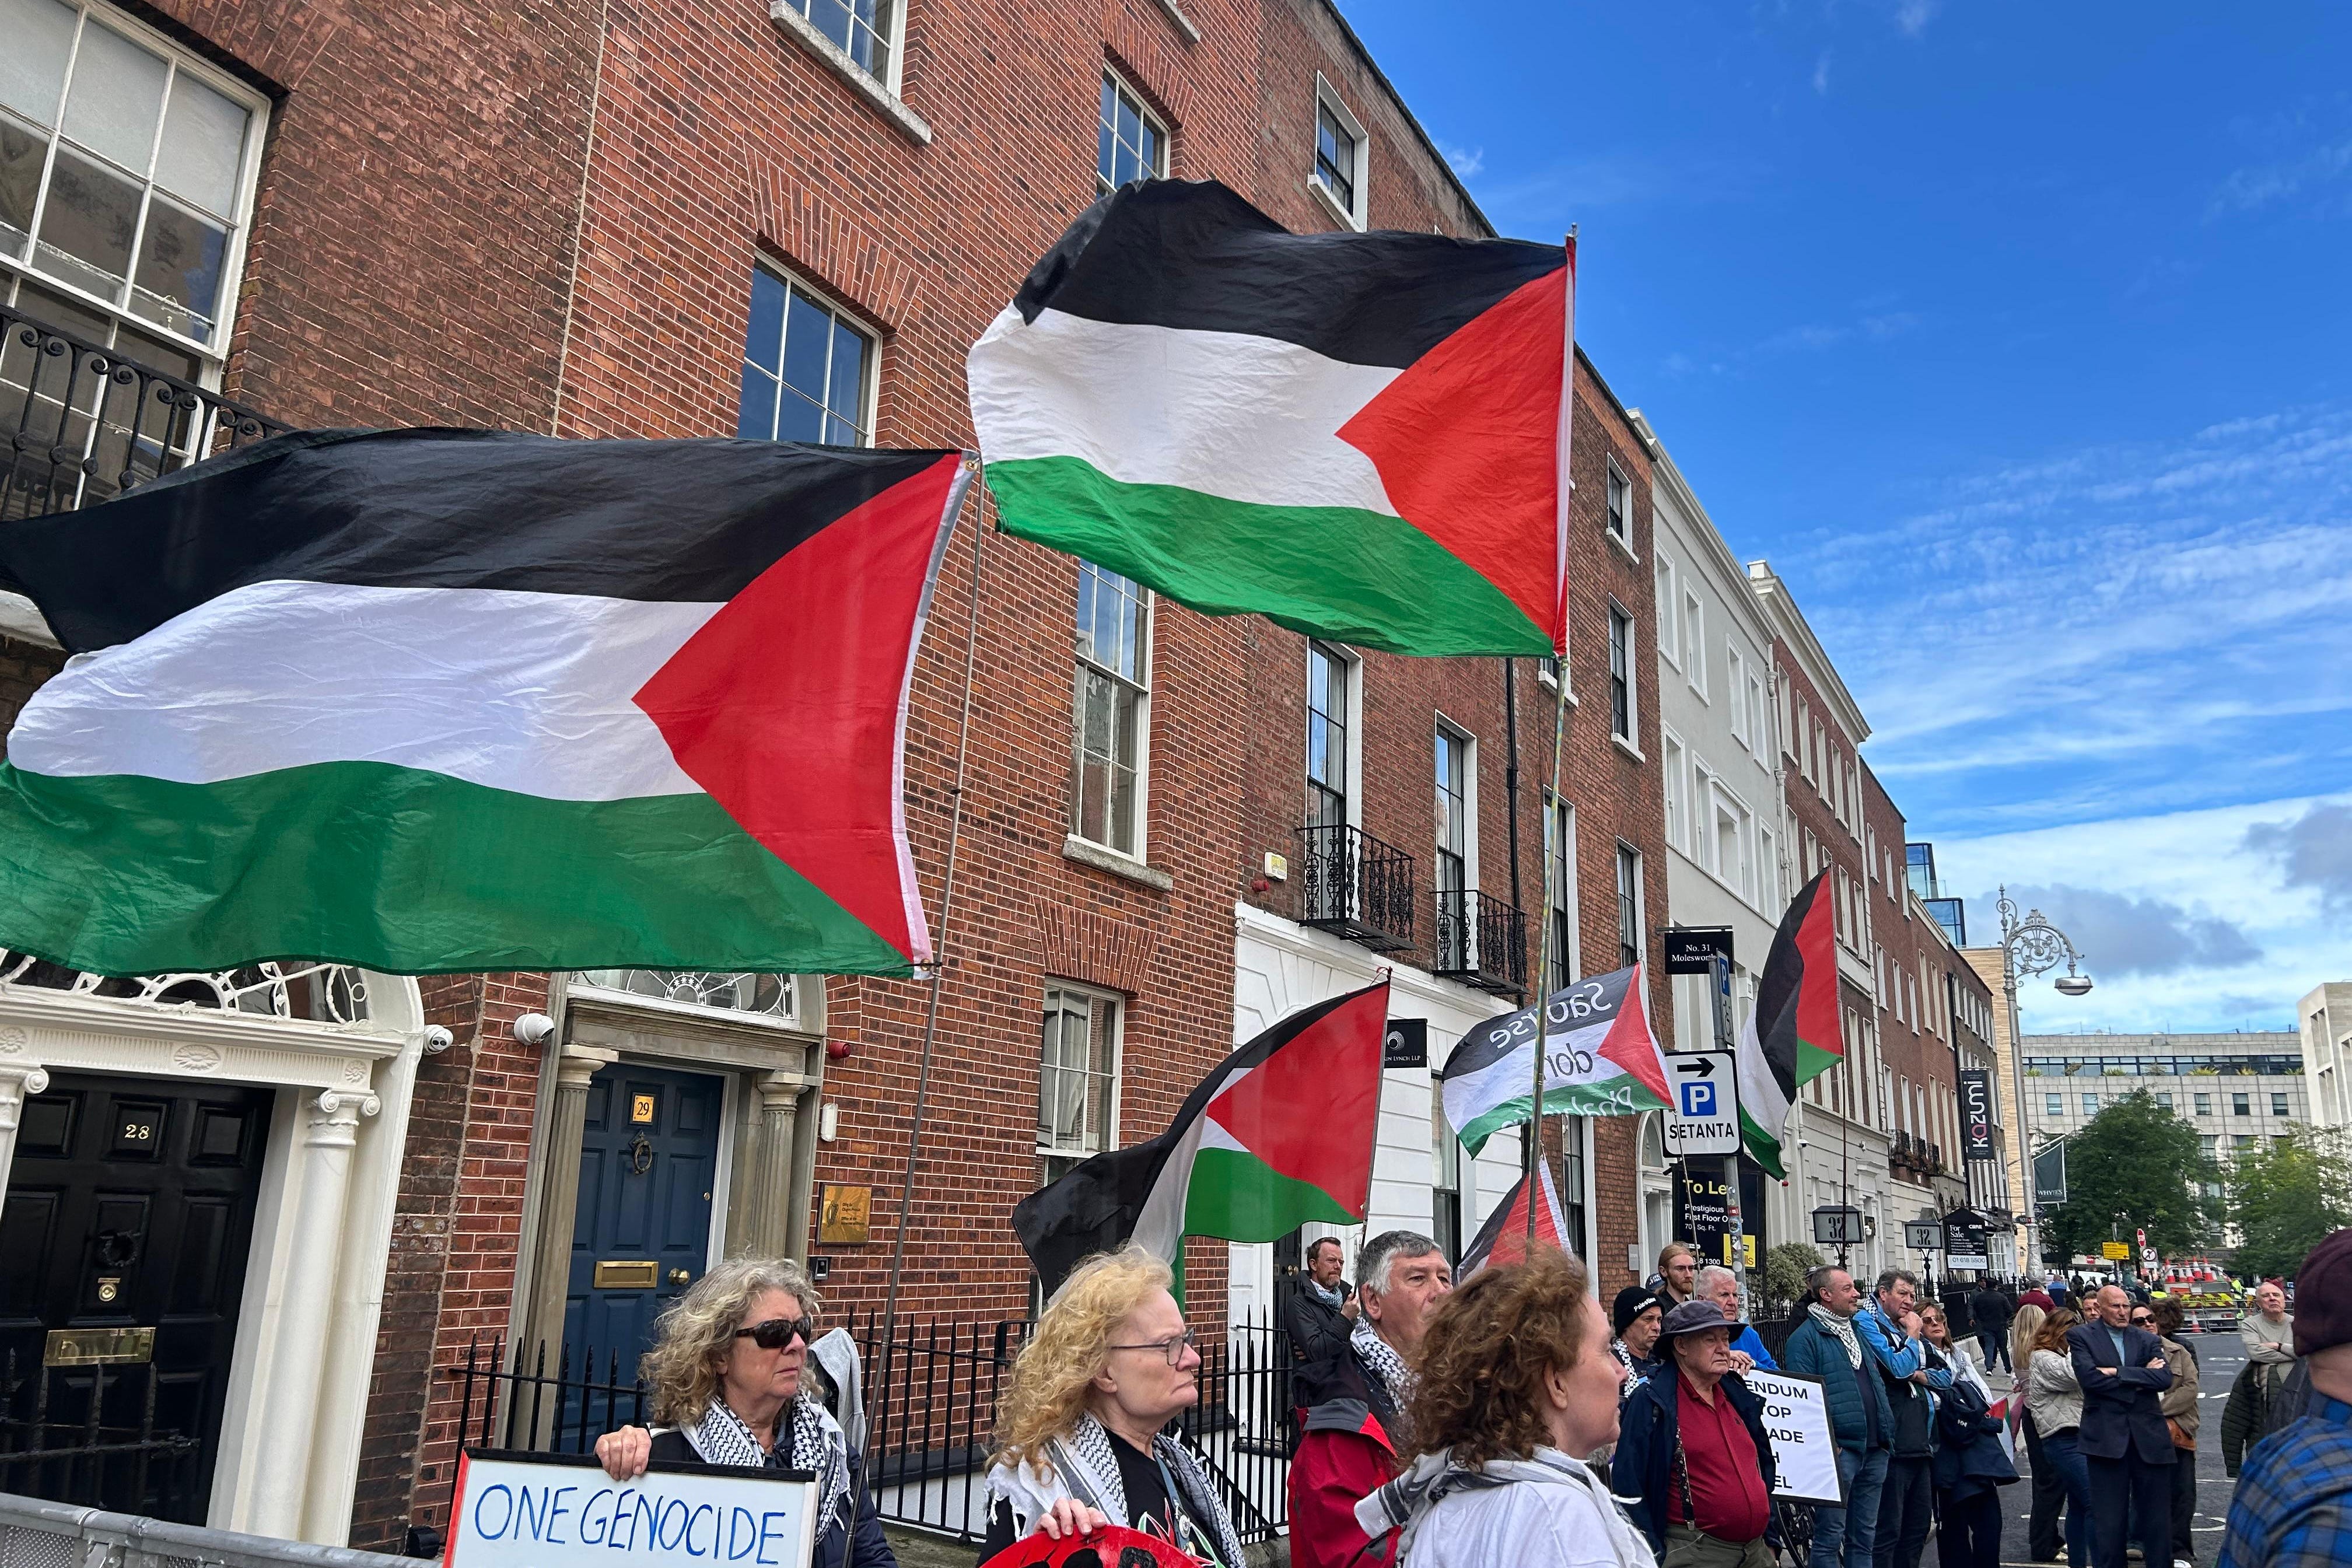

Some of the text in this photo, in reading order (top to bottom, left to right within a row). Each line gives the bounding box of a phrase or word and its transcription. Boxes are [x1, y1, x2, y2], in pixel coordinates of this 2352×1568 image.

[1685, 944, 1700, 952] No.
[1672, 954, 1713, 962] Moleswor
[1721, 964, 1727, 989] P
[1689, 1086, 1710, 1113] P
[636, 1101, 650, 1116] 29
[1964, 1081, 1989, 1147] kazumi
[124, 1124, 150, 1139] 28
[1670, 1123, 1734, 1139] SETANTA
[1682, 1180, 1727, 1195] To Le
[1702, 1214, 1720, 1222] Floor
[1828, 1217, 1845, 1238] 32
[1917, 1228, 1930, 1245] 32
[1745, 1380, 1808, 1399] ENDUM
[475, 1483, 786, 1566] ONE GENOCIDE
